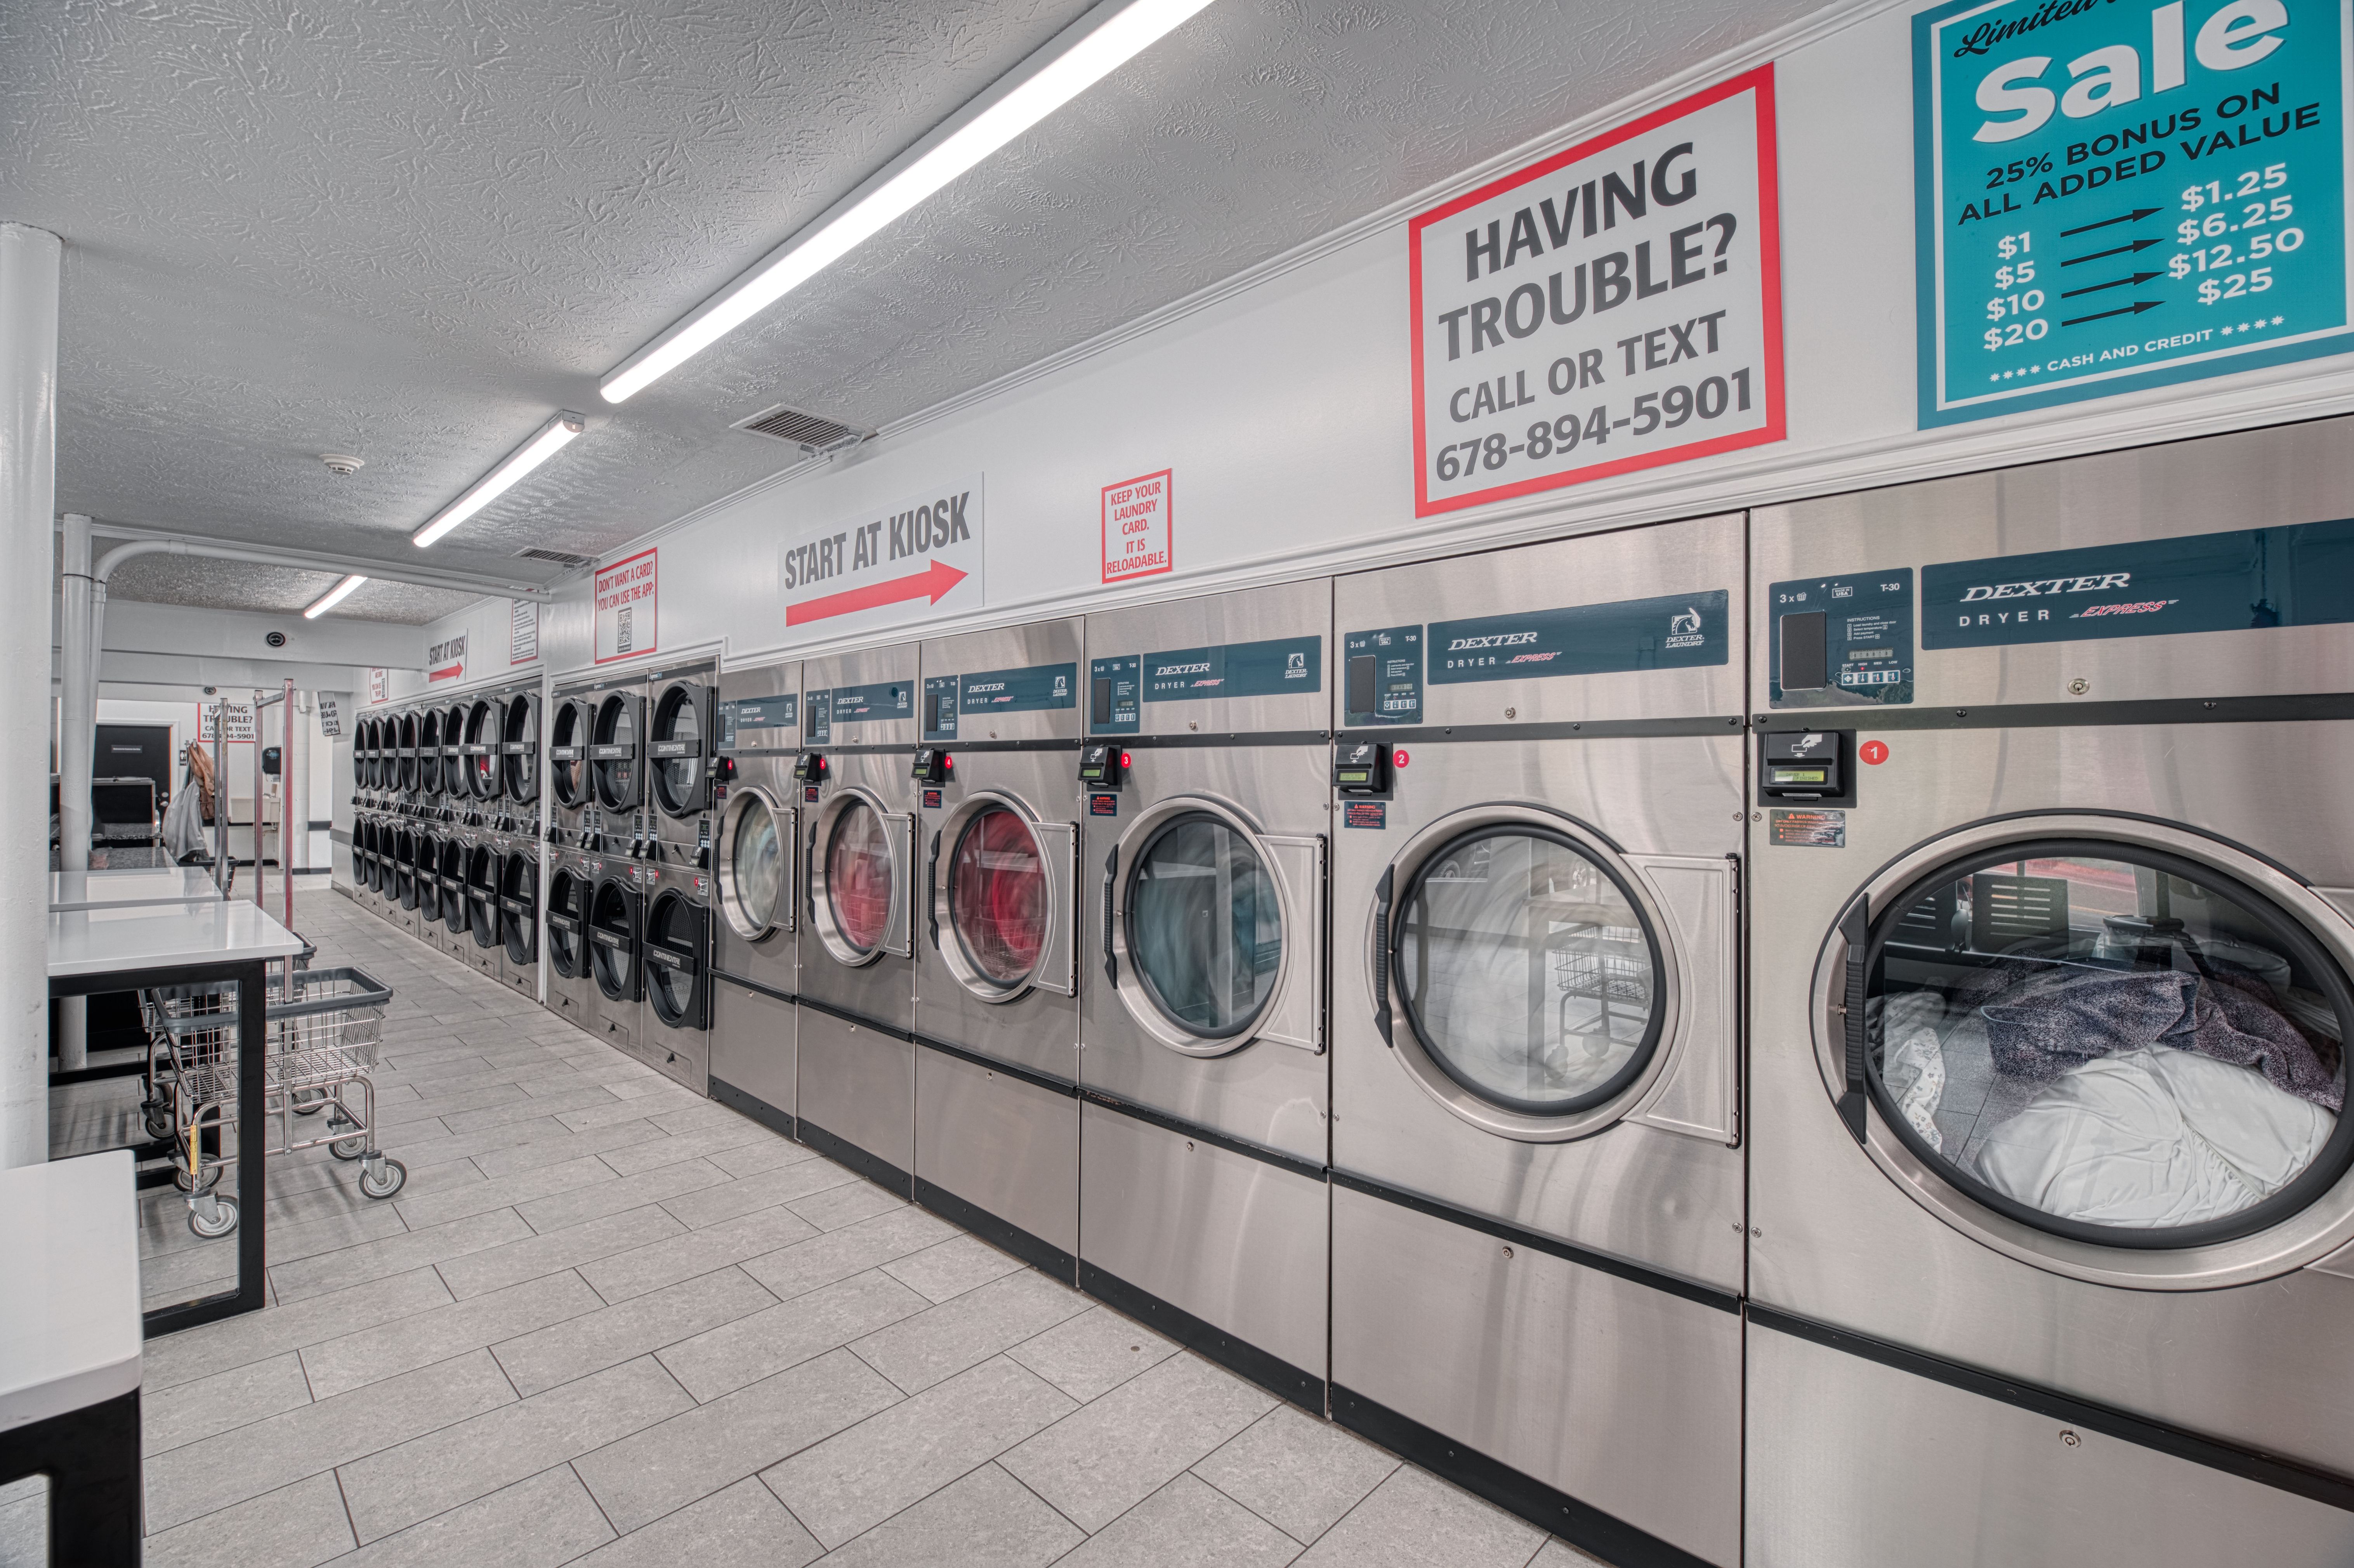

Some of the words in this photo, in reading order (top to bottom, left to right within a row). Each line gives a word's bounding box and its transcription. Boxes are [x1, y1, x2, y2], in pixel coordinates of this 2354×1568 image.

[1972, 0, 2290, 143] Sale
[1986, 152, 2054, 189] 25%
[2066, 108, 2201, 165] BONUS
[2216, 82, 2280, 118] ON
[1958, 193, 2021, 225] ALL
[2033, 150, 2166, 204] ADDED
[2180, 102, 2320, 160] VALUE
[1465, 142, 1697, 282] HAVING
[1998, 231, 2031, 260] $1
[2181, 163, 2287, 212] $1.25
[1995, 261, 2035, 290] $5
[2177, 195, 2293, 245] $6.25
[1438, 212, 1737, 361] TROUBLE?
[1986, 290, 2044, 321] $10
[2168, 228, 2304, 280] $12.50
[1983, 319, 2048, 352] $20
[2197, 267, 2272, 305] $25
[2047, 353, 2094, 371] CASH
[2099, 345, 2139, 362] AND
[2144, 329, 2213, 352] CREDIT
[1450, 370, 1535, 423] CALL
[1548, 349, 1605, 395] OR
[1617, 309, 1726, 376] TEXT
[1436, 367, 1751, 482] 678-894-5901
[1111, 489, 1132, 506] KEEP
[1135, 481, 1161, 499] YOUR
[1115, 499, 1157, 521] LAUNDRY
[1122, 519, 1149, 535] CARD.
[785, 532, 846, 589] START
[853, 521, 881, 571] AT
[889, 491, 970, 561] KIOSK
[1127, 541, 1134, 554] IT
[1137, 538, 1145, 552] IS
[615, 569, 629, 587] WANT
[631, 568, 635, 582] A
[636, 561, 653, 579] CARD?
[1107, 551, 1167, 574] RELOADABLE.
[598, 597, 608, 611] YOU
[609, 593, 619, 608] CAN
[621, 589, 630, 604] USE
[631, 585, 641, 601] THE
[642, 581, 654, 598] APP:
[1780, 595, 1786, 603] 3
[1880, 583, 1900, 591] T-30
[1960, 573, 2130, 602] DEXTER
[1959, 609, 2049, 626] DRYER
[2080, 601, 2167, 617] EXPRESS
[429, 644, 443, 666] START
[443, 641, 450, 661] AT
[450, 635, 465, 659] KIOSK
[1448, 632, 1537, 650] DEXTER
[1155, 663, 1210, 675] DEXTER
[1448, 657, 1495, 668] DRYER
[1511, 652, 1556, 663] EXPRESS
[968, 683, 1004, 693] DEXTER
[203, 715, 253, 723] TRUBLE?
[1399, 755, 1404, 763] 2
[1870, 747, 1877, 759] 1
[597, 932, 619, 945] CONTINENTAL
[654, 950, 680, 964] CONTINENTAL
